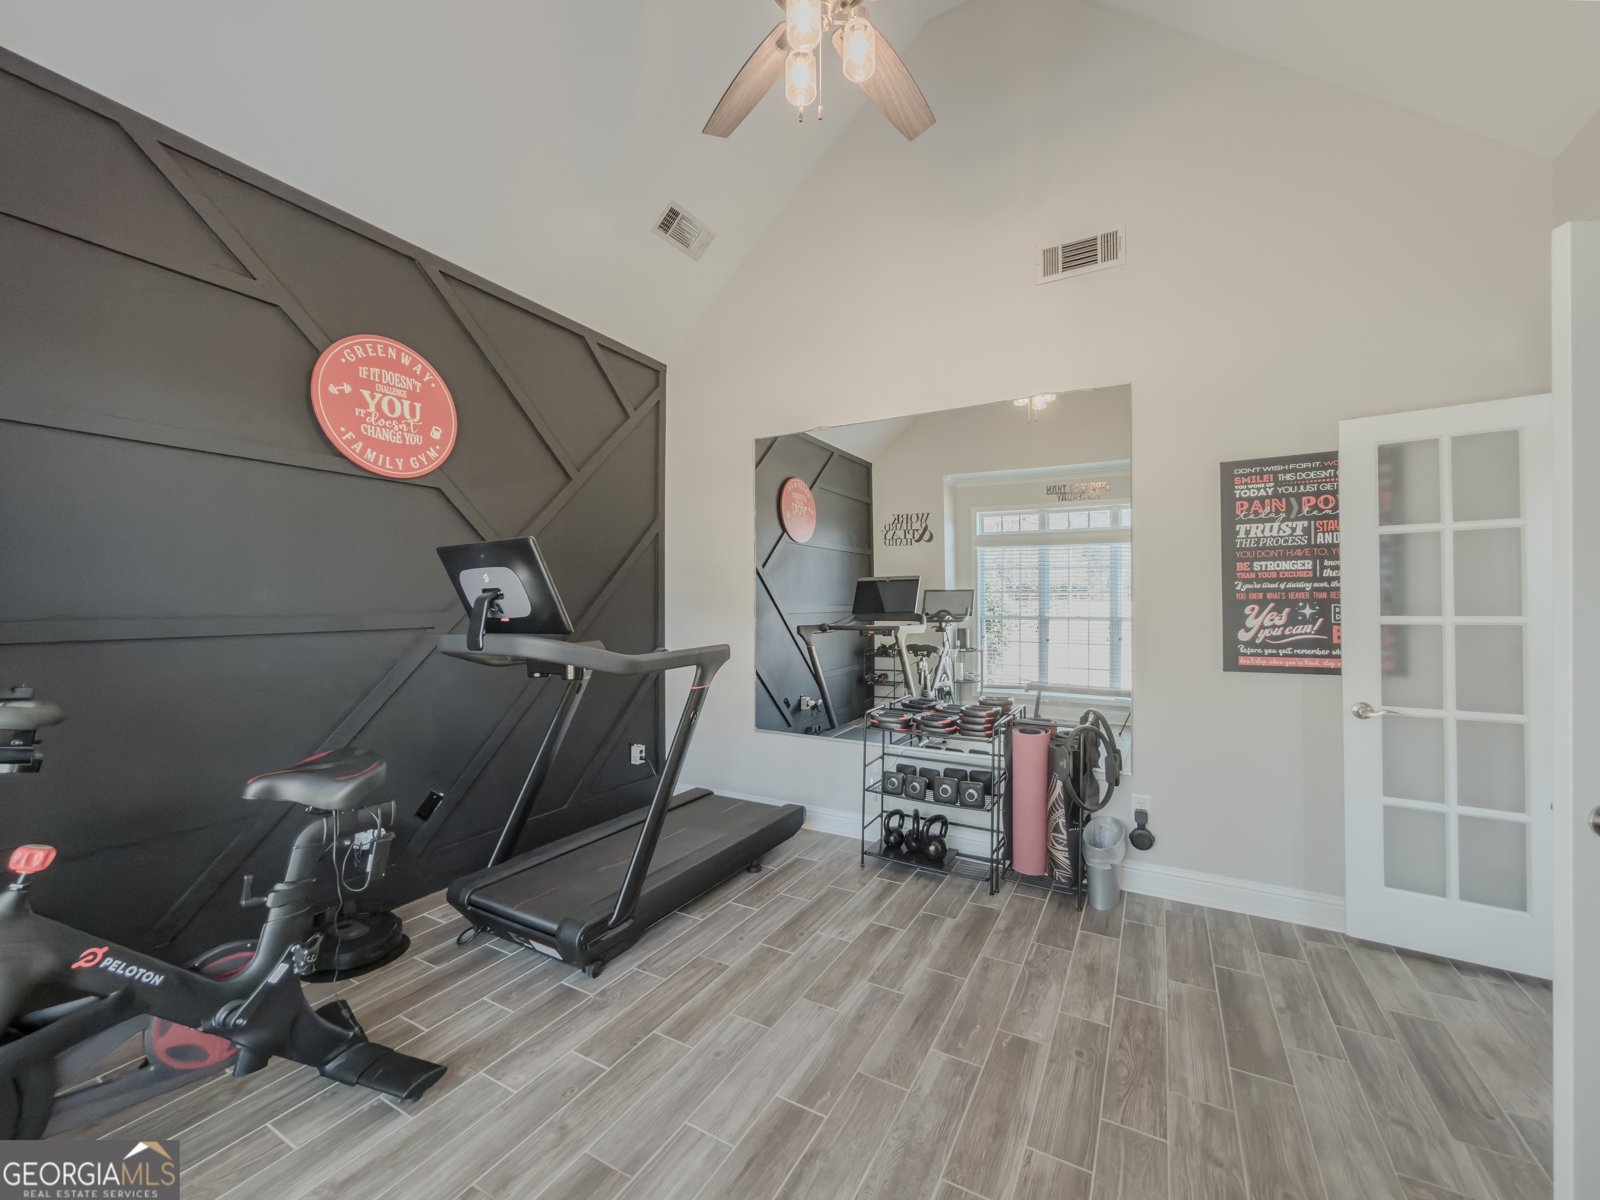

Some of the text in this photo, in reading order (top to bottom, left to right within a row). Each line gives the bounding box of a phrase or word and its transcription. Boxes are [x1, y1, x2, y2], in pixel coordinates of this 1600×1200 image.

[343, 343, 433, 383] GREENWAY
[358, 366, 422, 393] IF IT DOESN'T
[375, 383, 408, 398] CHALLENGE
[360, 388, 422, 423] YOU
[355, 407, 366, 417] IT
[361, 423, 423, 445] CHANGE YOU
[342, 431, 438, 470] FAMILY GYM
[1262, 464, 1288, 472] WISH
[1289, 462, 1311, 470] FOR
[1234, 473, 1274, 485] SMILE!
[1277, 472, 1296, 482] THIS
[1234, 487, 1274, 498] TODAY
[1277, 482, 1338, 494] YOU JUST GET
[1235, 494, 1340, 516] PAIN PO
[1235, 520, 1308, 538] TRUST
[1235, 536, 1308, 548] THE PROCESS
[1316, 532, 1340, 544] AND
[1235, 550, 1255, 559] YOU
[1286, 548, 1310, 557] HAVE
[1236, 559, 1313, 572] BE STRONGER
[1279, 570, 1313, 578] EXCUSES
[1279, 581, 1286, 590] of
[1286, 581, 1313, 591] starting
[1235, 592, 1247, 600] YOU
[1248, 592, 1264, 600] KNOW
[1288, 592, 1310, 600] HEAVIER
[1313, 591, 1328, 599] THAN
[1237, 602, 1291, 642] Yes
[1255, 617, 1324, 644] you can!
[1238, 644, 1263, 655] Before
[1264, 648, 1278, 656] you
[1293, 648, 1331, 656] remember
[98, 956, 165, 986] PELOTON
